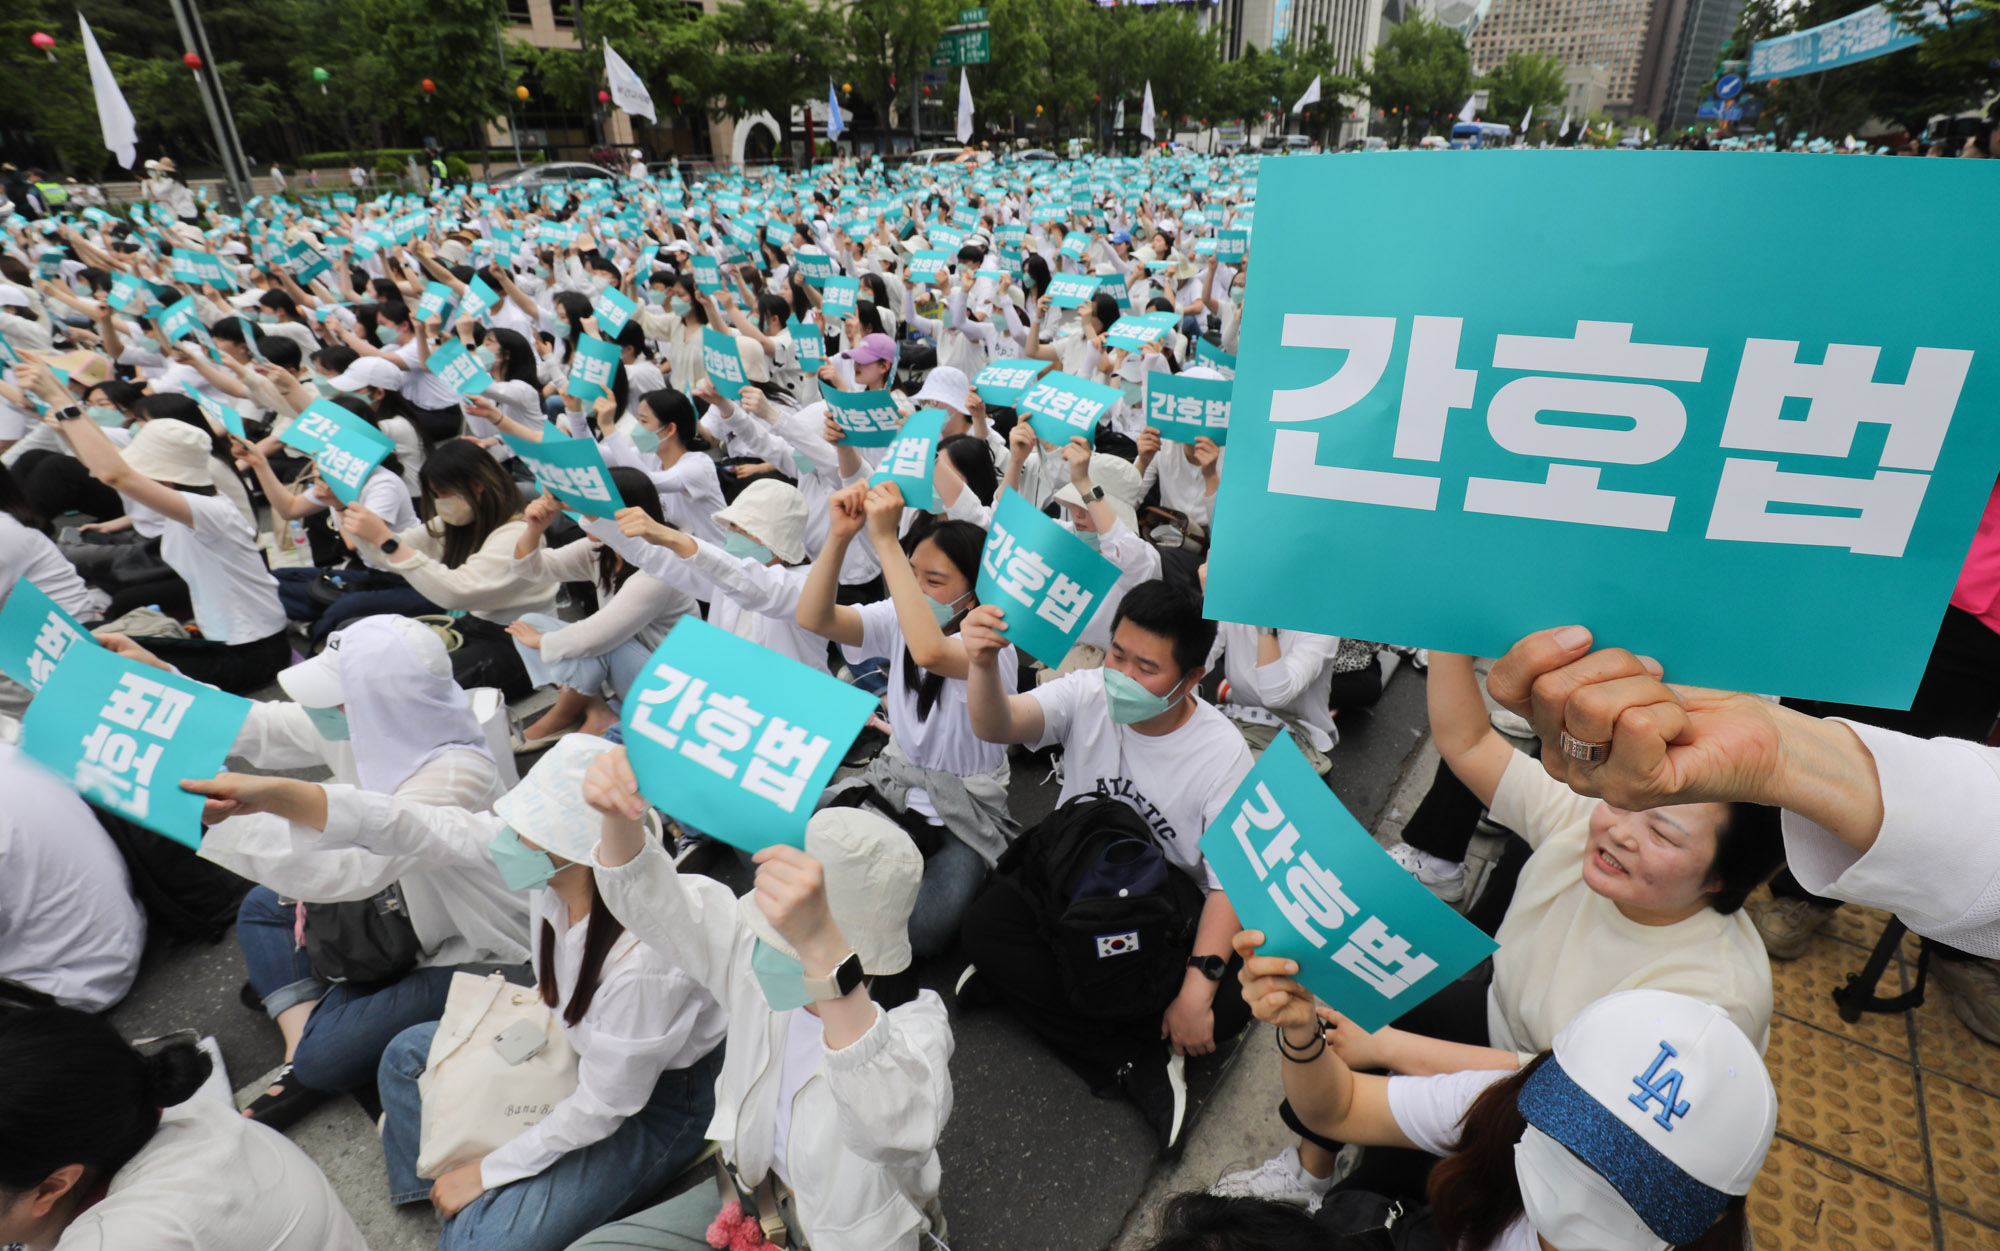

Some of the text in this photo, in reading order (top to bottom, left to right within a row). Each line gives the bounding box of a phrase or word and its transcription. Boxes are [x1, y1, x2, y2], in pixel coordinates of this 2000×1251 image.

[929, 230, 961, 246] 간호법
[911, 258, 945, 273] 간호법
[1050, 281, 1093, 298] 간호법
[1110, 323, 1162, 341] 간호법
[975, 367, 1036, 390] 간호법
[297, 411, 341, 441] 간
[831, 405, 900, 432] 간호법
[1023, 384, 1104, 431] 간호법
[1151, 391, 1231, 428] 간호법
[1267, 312, 1975, 558] 간호법
[316, 444, 370, 488] 간호법
[983, 522, 1093, 634] 간호법
[75, 671, 195, 819] 간호법
[630, 663, 832, 813] 간호법
[1231, 780, 1439, 1000] 간호법
[1628, 1040, 1691, 1132] LA
